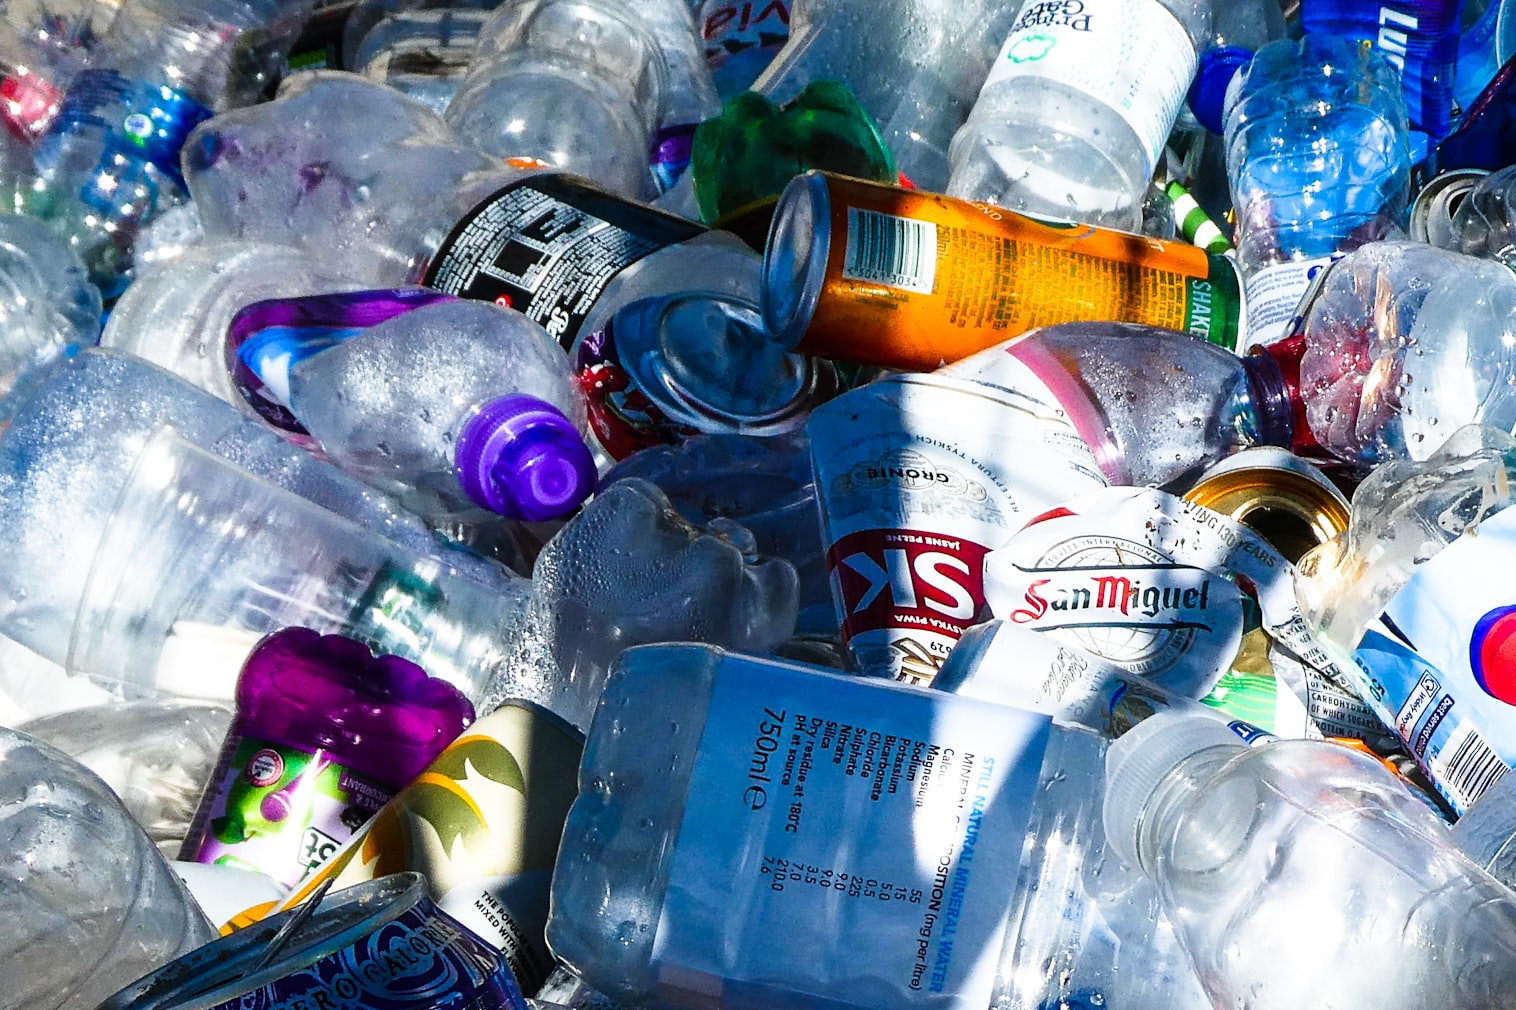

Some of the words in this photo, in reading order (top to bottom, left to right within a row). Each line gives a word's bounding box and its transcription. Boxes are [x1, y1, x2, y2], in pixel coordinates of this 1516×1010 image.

[863, 456, 950, 492] GRONIE
[922, 534, 960, 552] JASNE
[1234, 542, 1278, 569] YEARS
[1010, 575, 1092, 628] San
[1088, 572, 1210, 622] Miguel
[893, 610, 928, 628] PIWA
[1310, 704, 1321, 713] OF
[1321, 706, 1346, 721] WHICH
[1410, 690, 1428, 712] Widely
[1439, 697, 1453, 713] best
[792, 713, 808, 732] pH
[805, 716, 824, 739] Dry
[819, 720, 838, 750] Silica
[1421, 712, 1442, 737] served
[790, 733, 803, 746] at
[830, 723, 852, 765] Nitrate
[843, 727, 867, 777] Sulphate
[795, 740, 817, 784] residue
[858, 730, 882, 779] Chloride
[885, 737, 911, 794] Potassium
[904, 740, 926, 782] Sodium
[779, 748, 800, 787] source
[869, 734, 897, 802] Bicarbonate
[911, 743, 942, 808] Magnesium
[974, 755, 996, 793] STILL
[792, 784, 806, 798] at
[955, 794, 988, 867] NATURAL
[758, 855, 774, 875] 7.6
[769, 858, 789, 892] 210.0
[788, 861, 804, 881] 7.0
[803, 864, 818, 884] 3.5
[817, 868, 833, 888] 9.0
[832, 871, 848, 891] 9.0
[846, 875, 863, 898] 225
[862, 878, 878, 898] 0.5
[479, 890, 498, 910] THE
[877, 882, 893, 901] 5.0
[892, 885, 907, 901] 15
[907, 888, 922, 904] 55
[938, 866, 971, 939] MINERAL
[473, 899, 500, 929] MIXED
[495, 925, 518, 950] WITH
[917, 911, 938, 939] (mg
[912, 938, 932, 961] per
[906, 962, 927, 992] litre)
[927, 939, 953, 993] WATER
